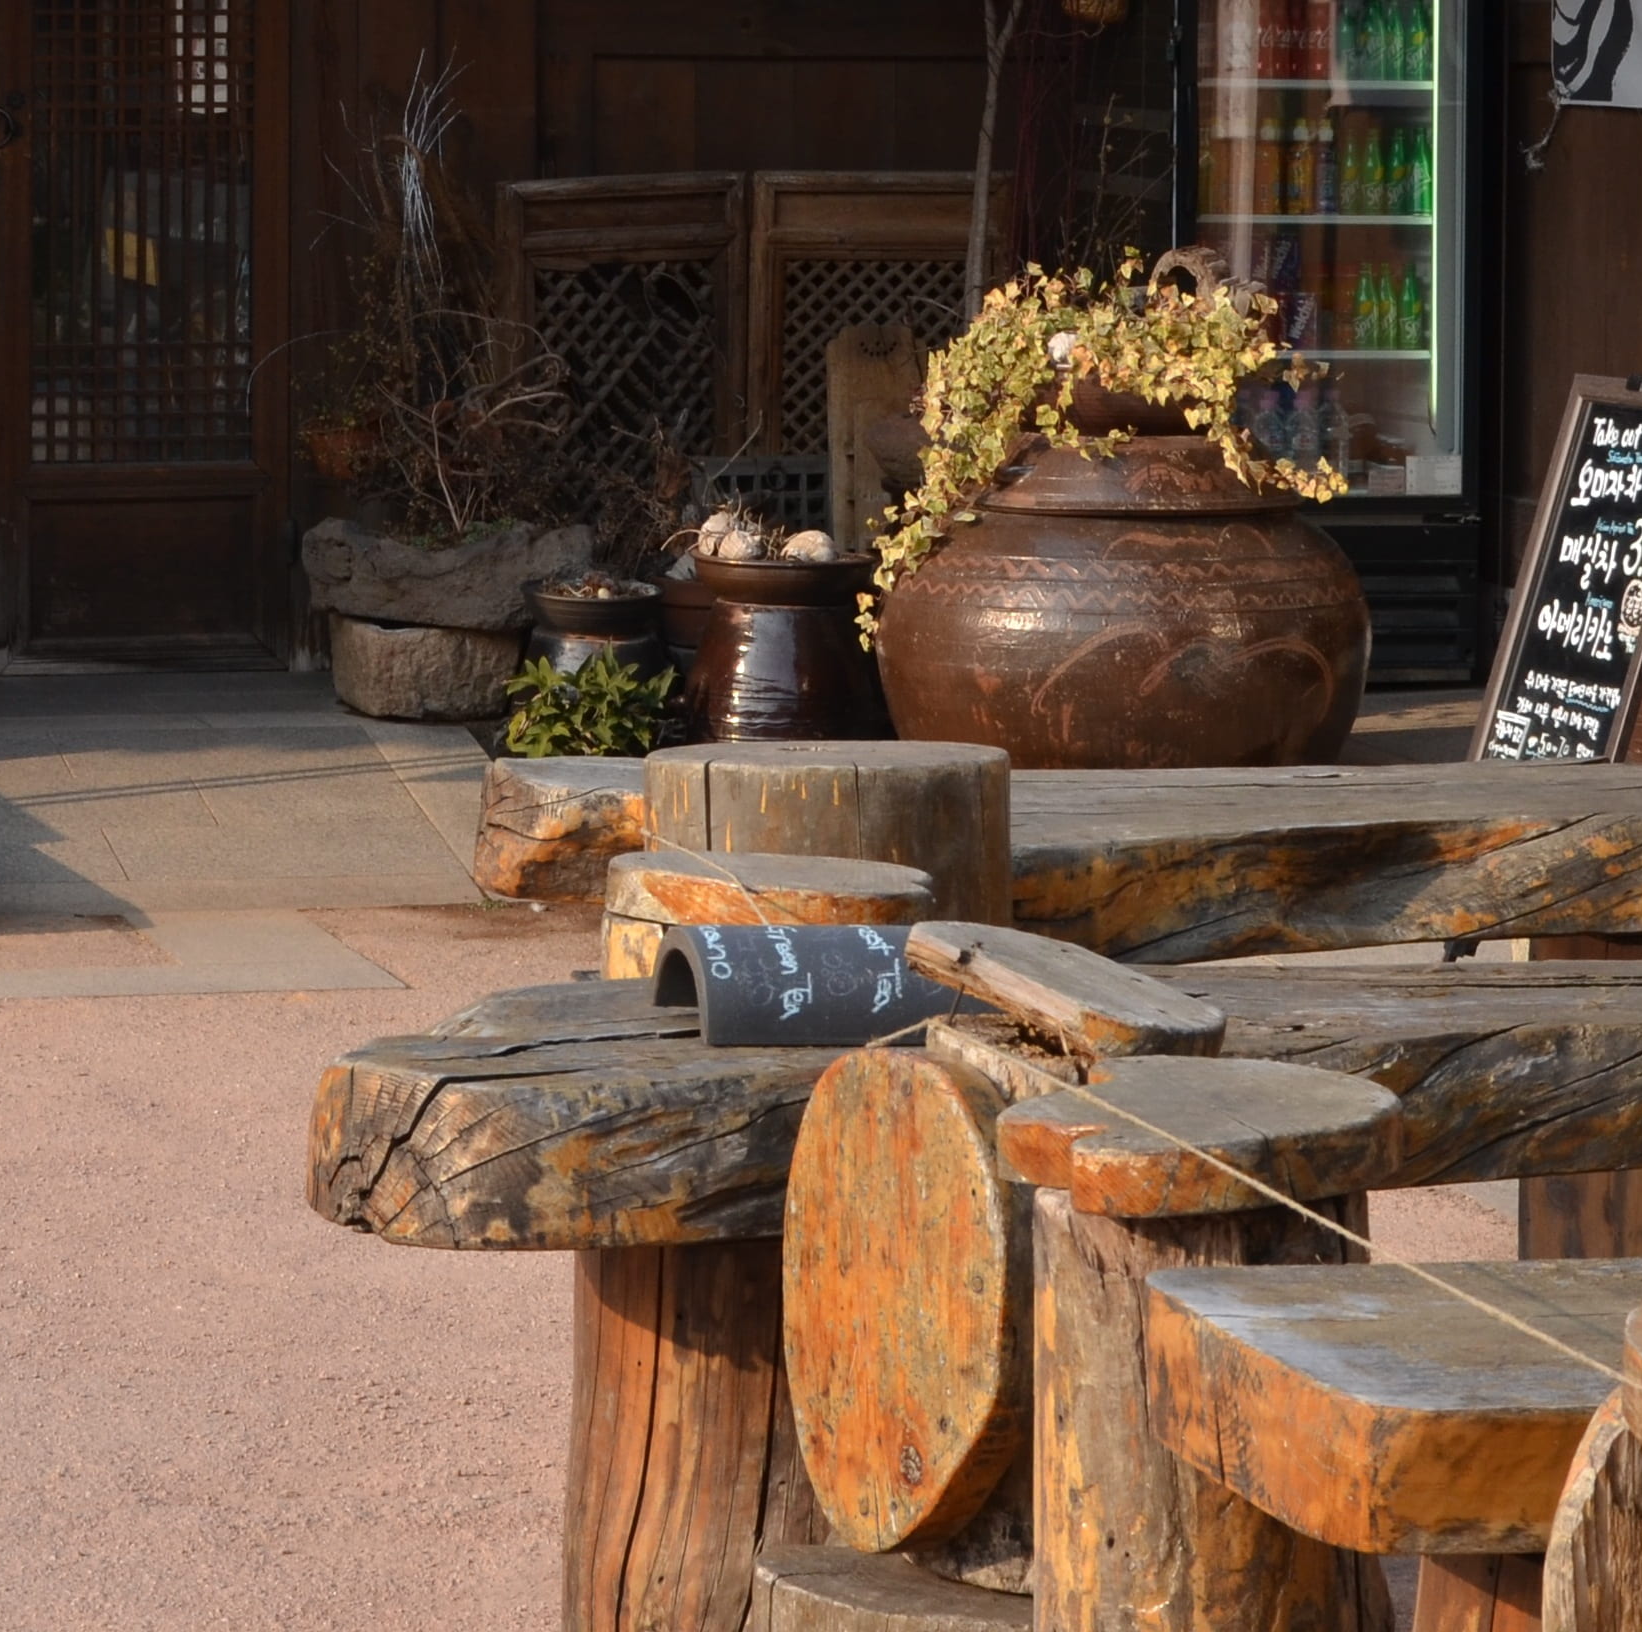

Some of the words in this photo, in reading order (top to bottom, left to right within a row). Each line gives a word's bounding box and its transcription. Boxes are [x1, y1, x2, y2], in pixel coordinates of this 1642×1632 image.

[1593, 417, 1619, 448] Take
[1559, 532, 1618, 590] 매실차
[1538, 598, 1613, 661] 아메리카노
[779, 971, 812, 1020] Tea
[871, 956, 903, 1015] Tea
